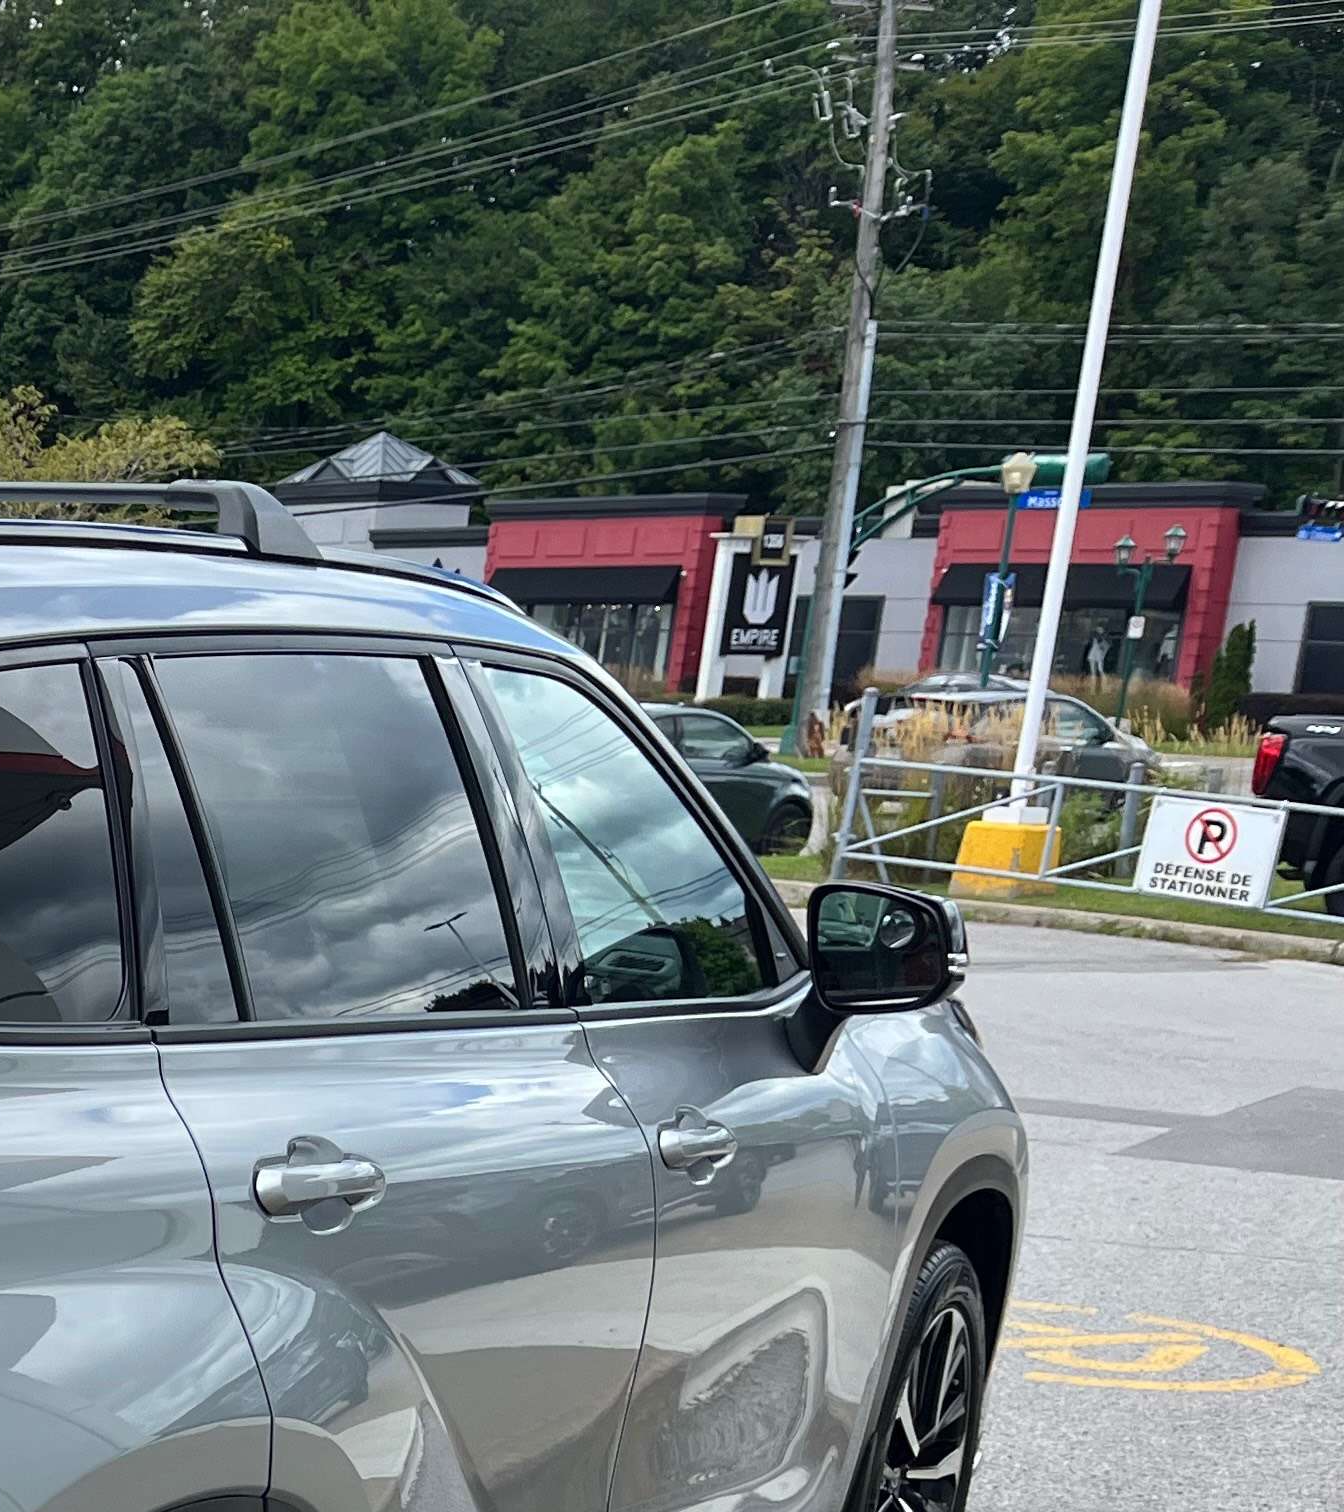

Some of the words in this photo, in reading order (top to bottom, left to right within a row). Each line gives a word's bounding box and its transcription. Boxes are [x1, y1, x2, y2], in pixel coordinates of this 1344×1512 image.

[731, 628, 780, 646] EMPIRE
[1230, 872, 1252, 887] DE
[1149, 876, 1250, 902] STATIONNER
